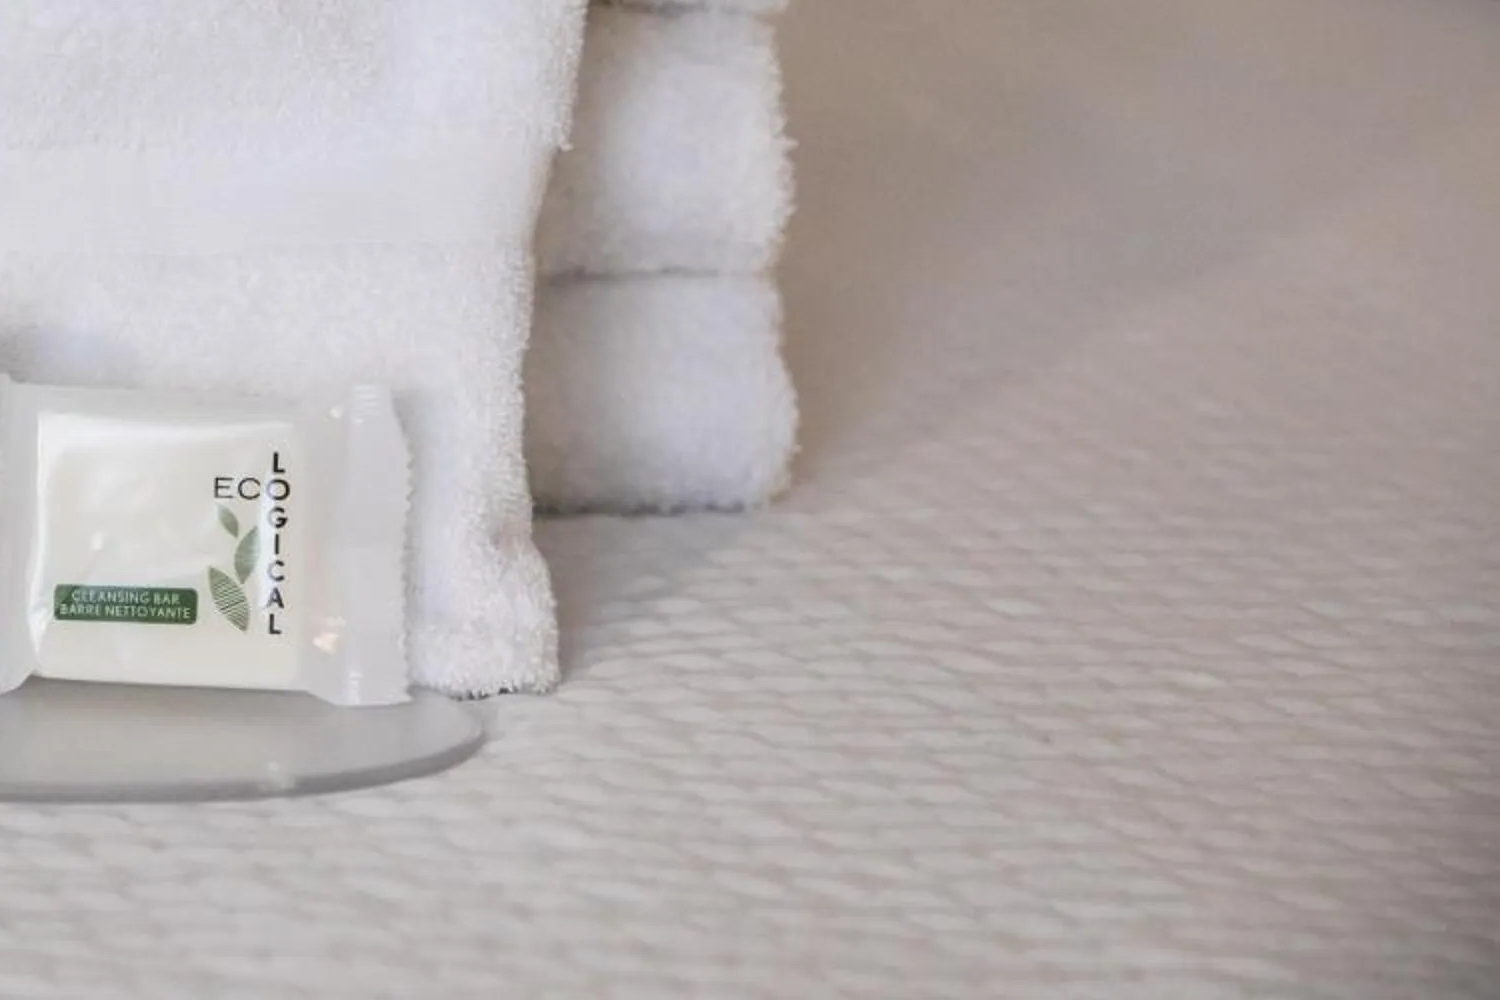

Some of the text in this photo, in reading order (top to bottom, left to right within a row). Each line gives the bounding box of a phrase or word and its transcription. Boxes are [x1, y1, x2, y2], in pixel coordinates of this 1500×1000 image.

[214, 476, 291, 501] ECO
[265, 451, 291, 636] LOGICAL
[71, 589, 181, 605] CLEANSING BAR
[59, 603, 192, 620] BARRE NETTOYANTE
